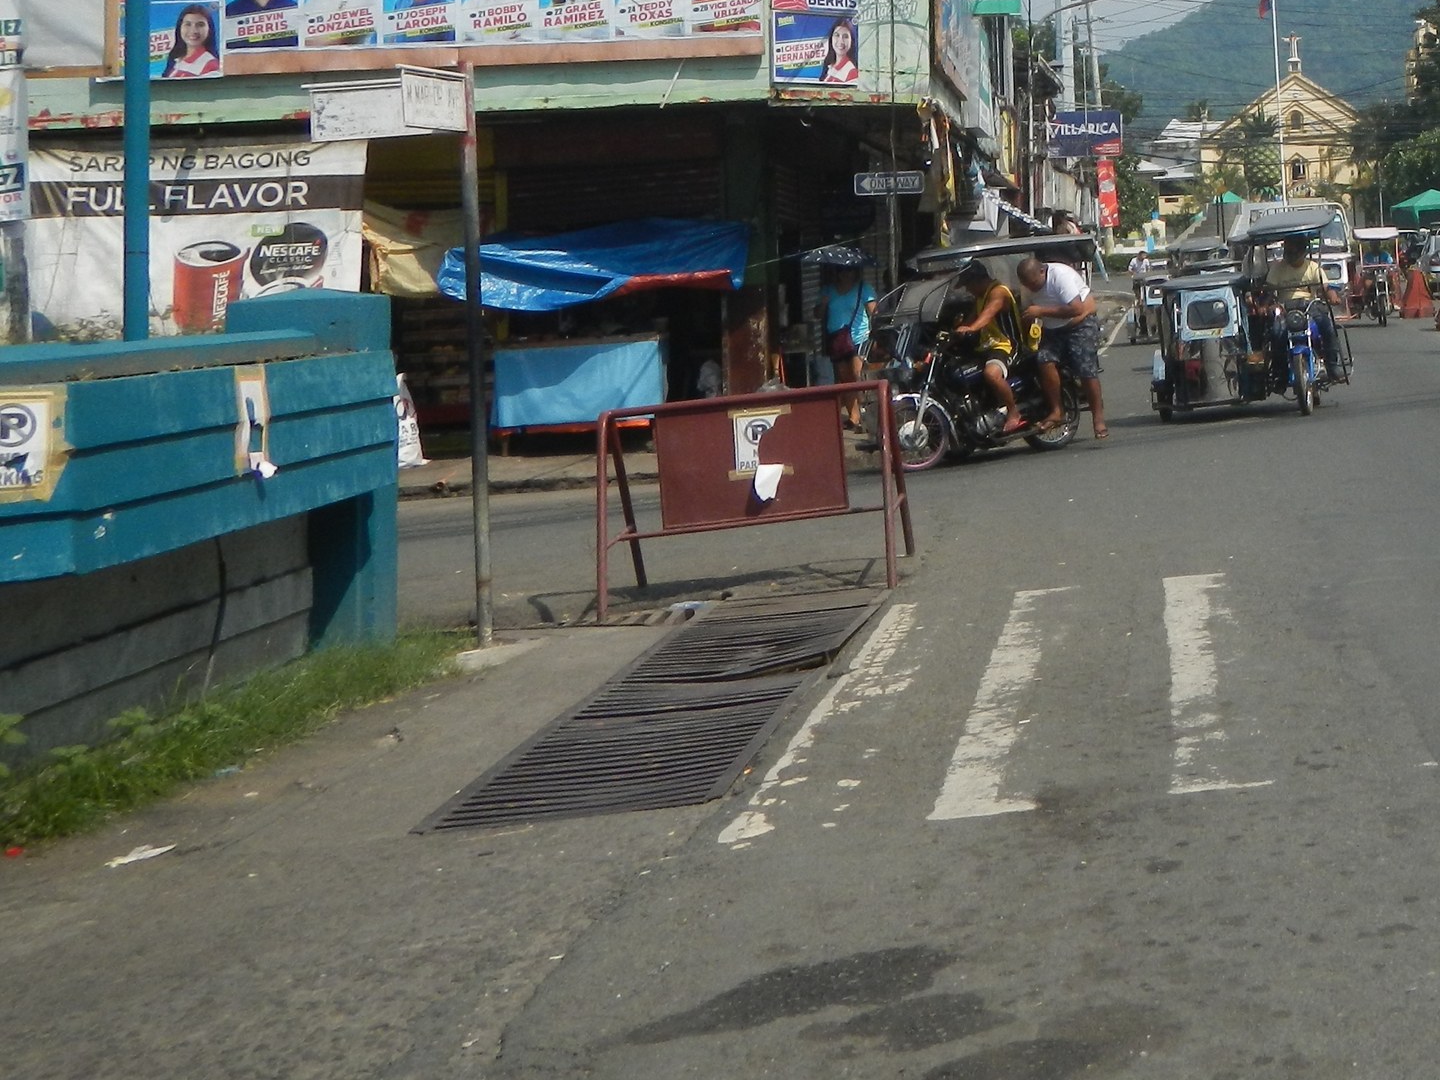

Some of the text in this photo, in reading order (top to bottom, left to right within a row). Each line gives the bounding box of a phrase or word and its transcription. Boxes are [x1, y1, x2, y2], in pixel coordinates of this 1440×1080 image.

[487, 4, 524, 17] BOBBY
[565, 1, 601, 14] GRACE
[638, 0, 674, 12] TEDDY
[709, 1, 727, 10] VICE
[252, 12, 284, 24] LEVIN
[327, 8, 372, 21] JOEWEL
[404, 6, 447, 19] JOSEPH
[544, 8, 605, 27] RAMIREZ
[629, 8, 673, 23] ROXAS
[307, 17, 374, 35] GONZALES
[396, 15, 448, 31] LARONA
[473, 12, 527, 29] RAMILO
[237, 20, 288, 36] BERRIS
[776, 50, 826, 63] HERNANDEZ
[1049, 122, 1119, 137] VILLARICA
[161, 154, 197, 170] NG
[204, 150, 311, 170] BAGONG
[870, 177, 893, 190] ONE
[164, 181, 308, 210] FLAVOR
[257, 225, 279, 234] NEW
[269, 256, 313, 264] CLASSIC
